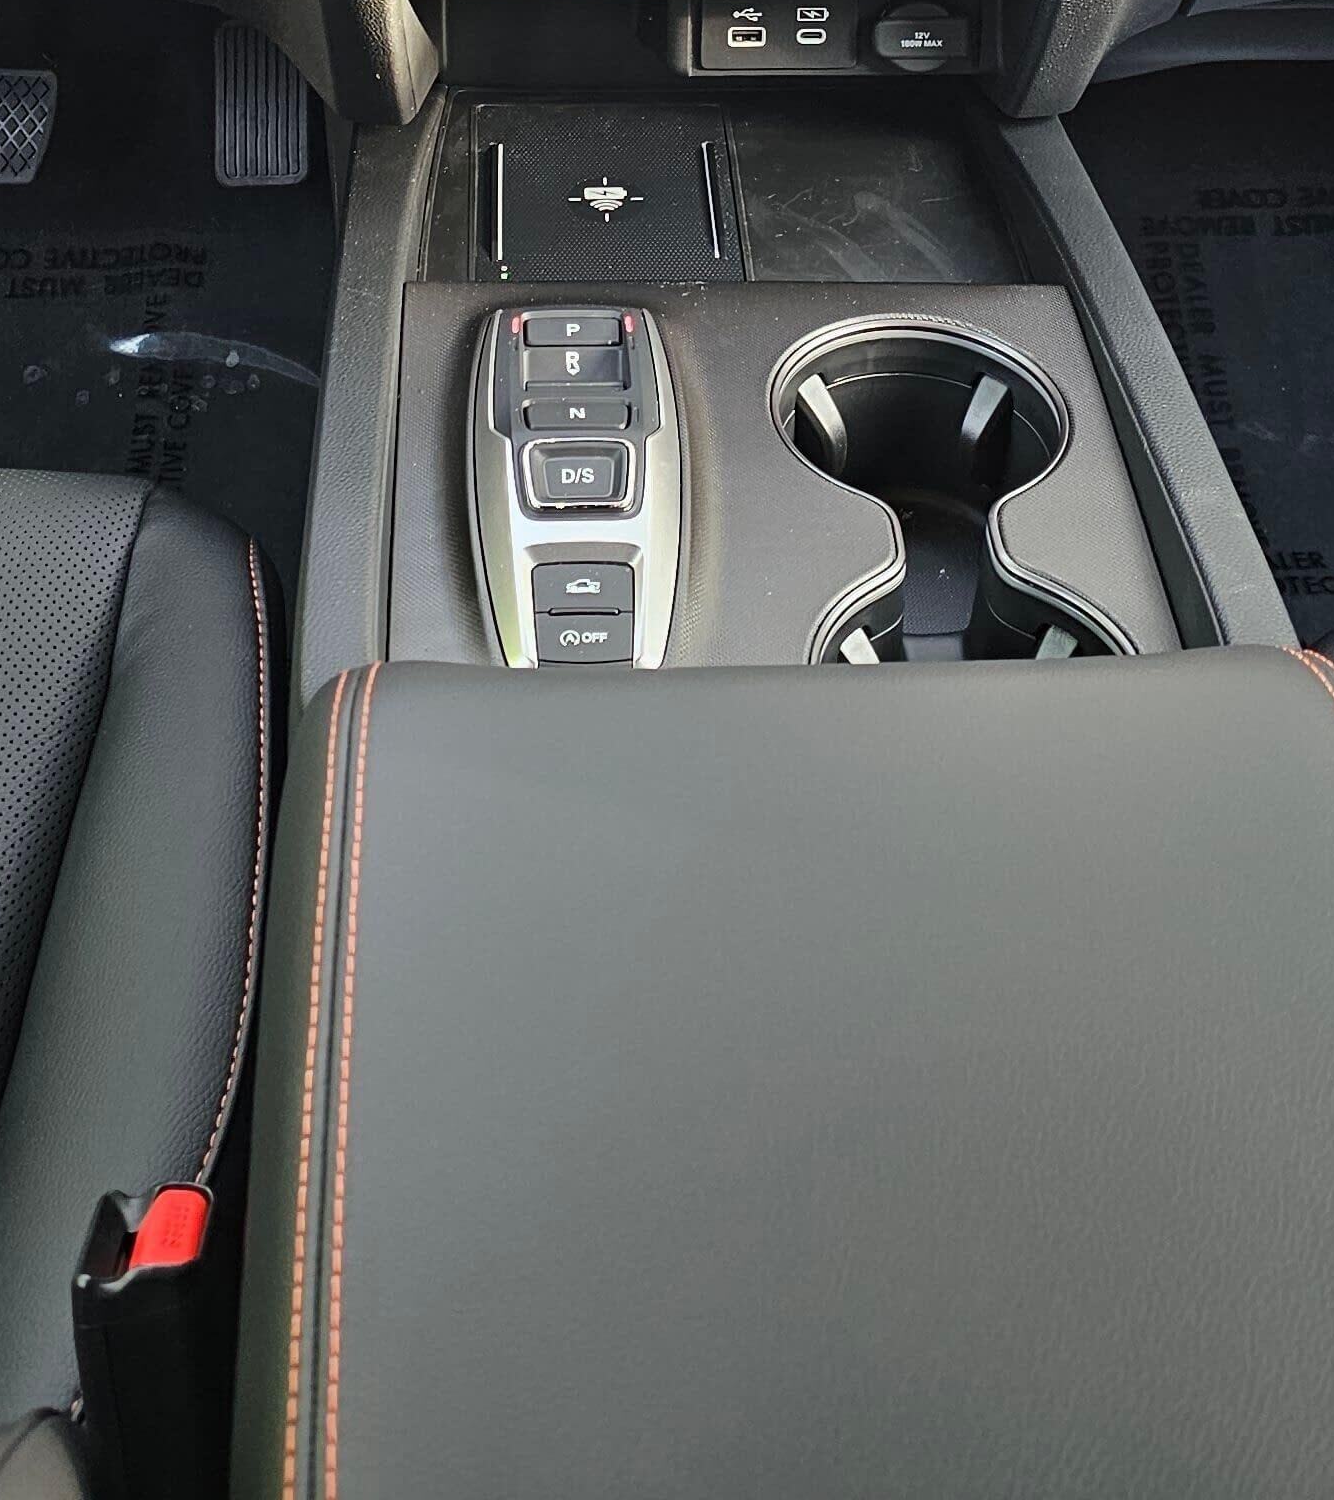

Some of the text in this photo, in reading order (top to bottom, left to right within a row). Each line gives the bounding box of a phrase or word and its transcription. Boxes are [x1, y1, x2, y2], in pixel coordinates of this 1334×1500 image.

[914, 31, 930, 40] 12V
[923, 39, 943, 48] MAX
[566, 323, 581, 337] P
[566, 351, 581, 368] R
[569, 407, 586, 420] N
[561, 467, 595, 486] D/S
[581, 631, 608, 644] OFF
